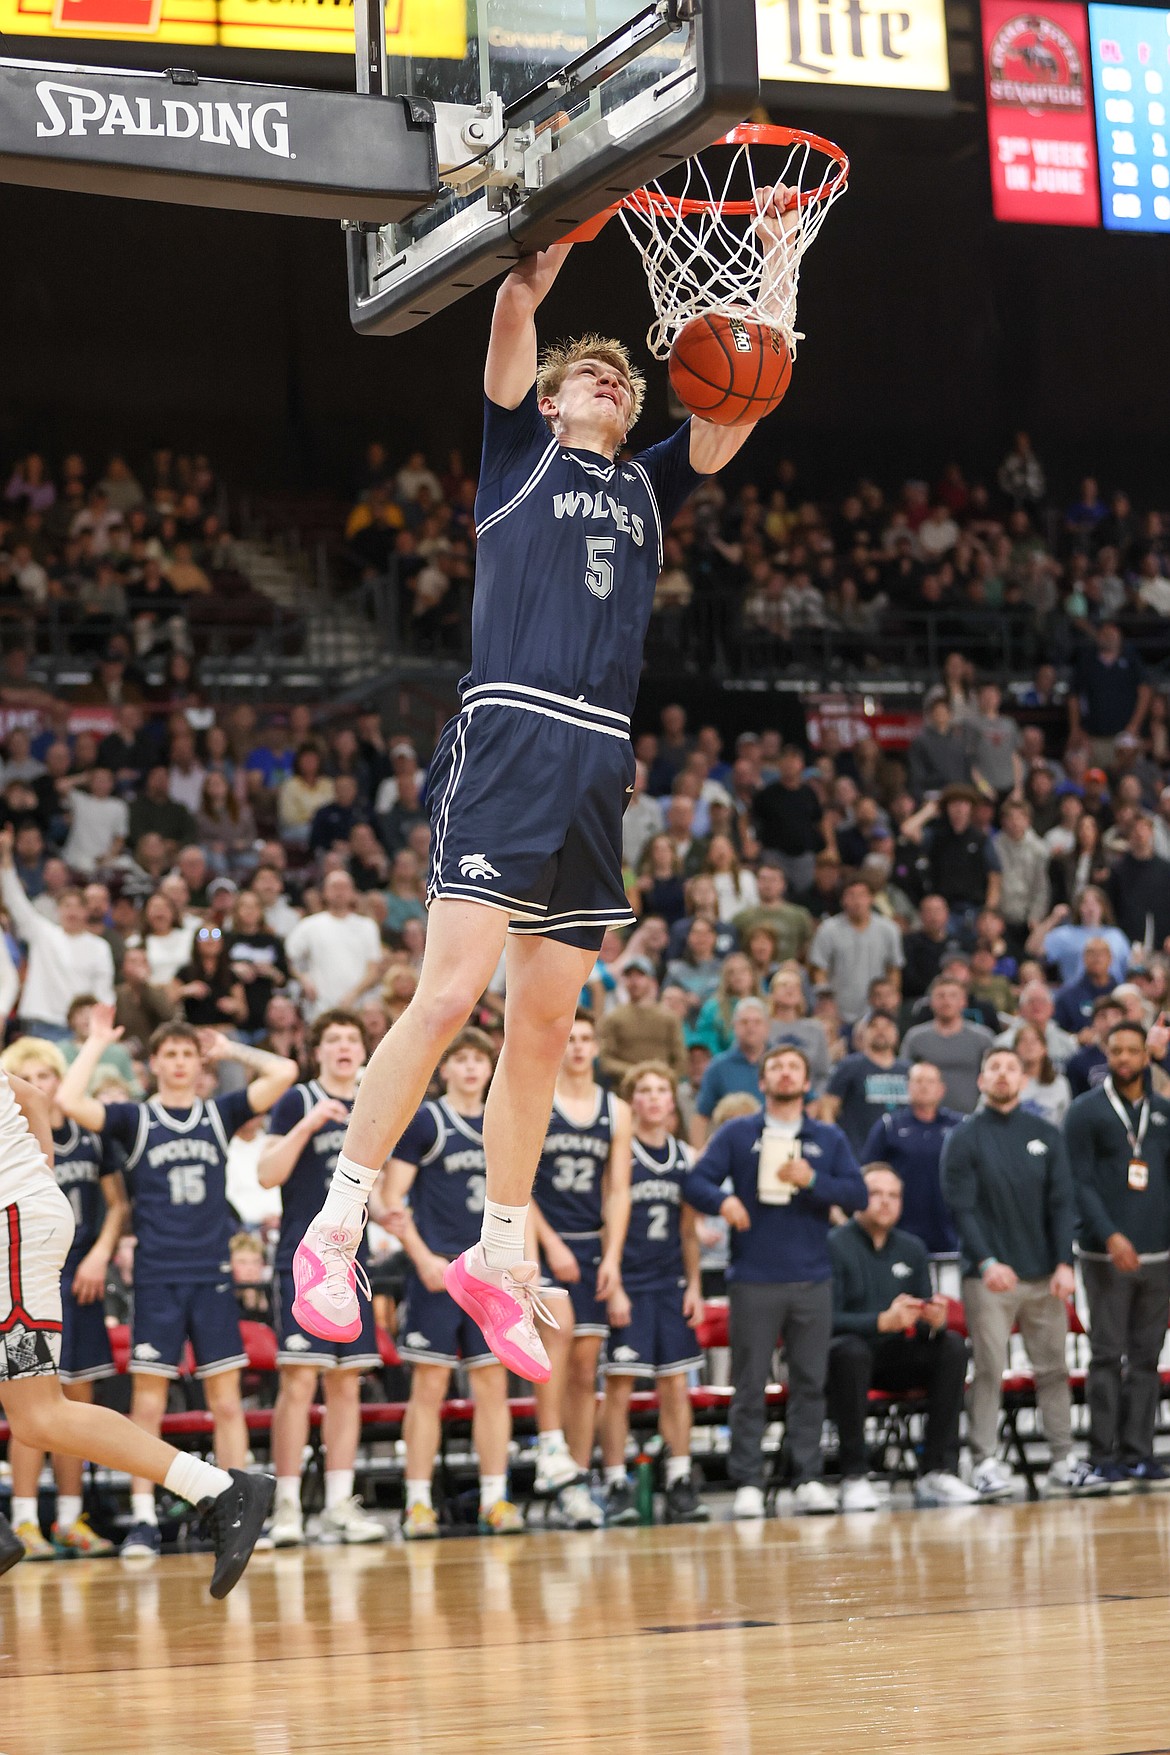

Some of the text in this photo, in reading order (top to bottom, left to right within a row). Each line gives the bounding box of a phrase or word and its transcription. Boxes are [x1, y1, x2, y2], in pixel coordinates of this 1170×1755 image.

[788, 0, 910, 74] Lite
[990, 79, 1085, 106] STAMPEDE
[35, 80, 290, 159] SPALDING
[1031, 138, 1088, 169] WEEK
[1004, 164, 1085, 195] IN JUNE
[553, 490, 645, 547] WOLVES
[584, 535, 616, 600] 5
[147, 1138, 219, 1168] WOLVES
[167, 1164, 206, 1206] 15
[552, 1154, 596, 1192] 32
[647, 1204, 669, 1241] 2
